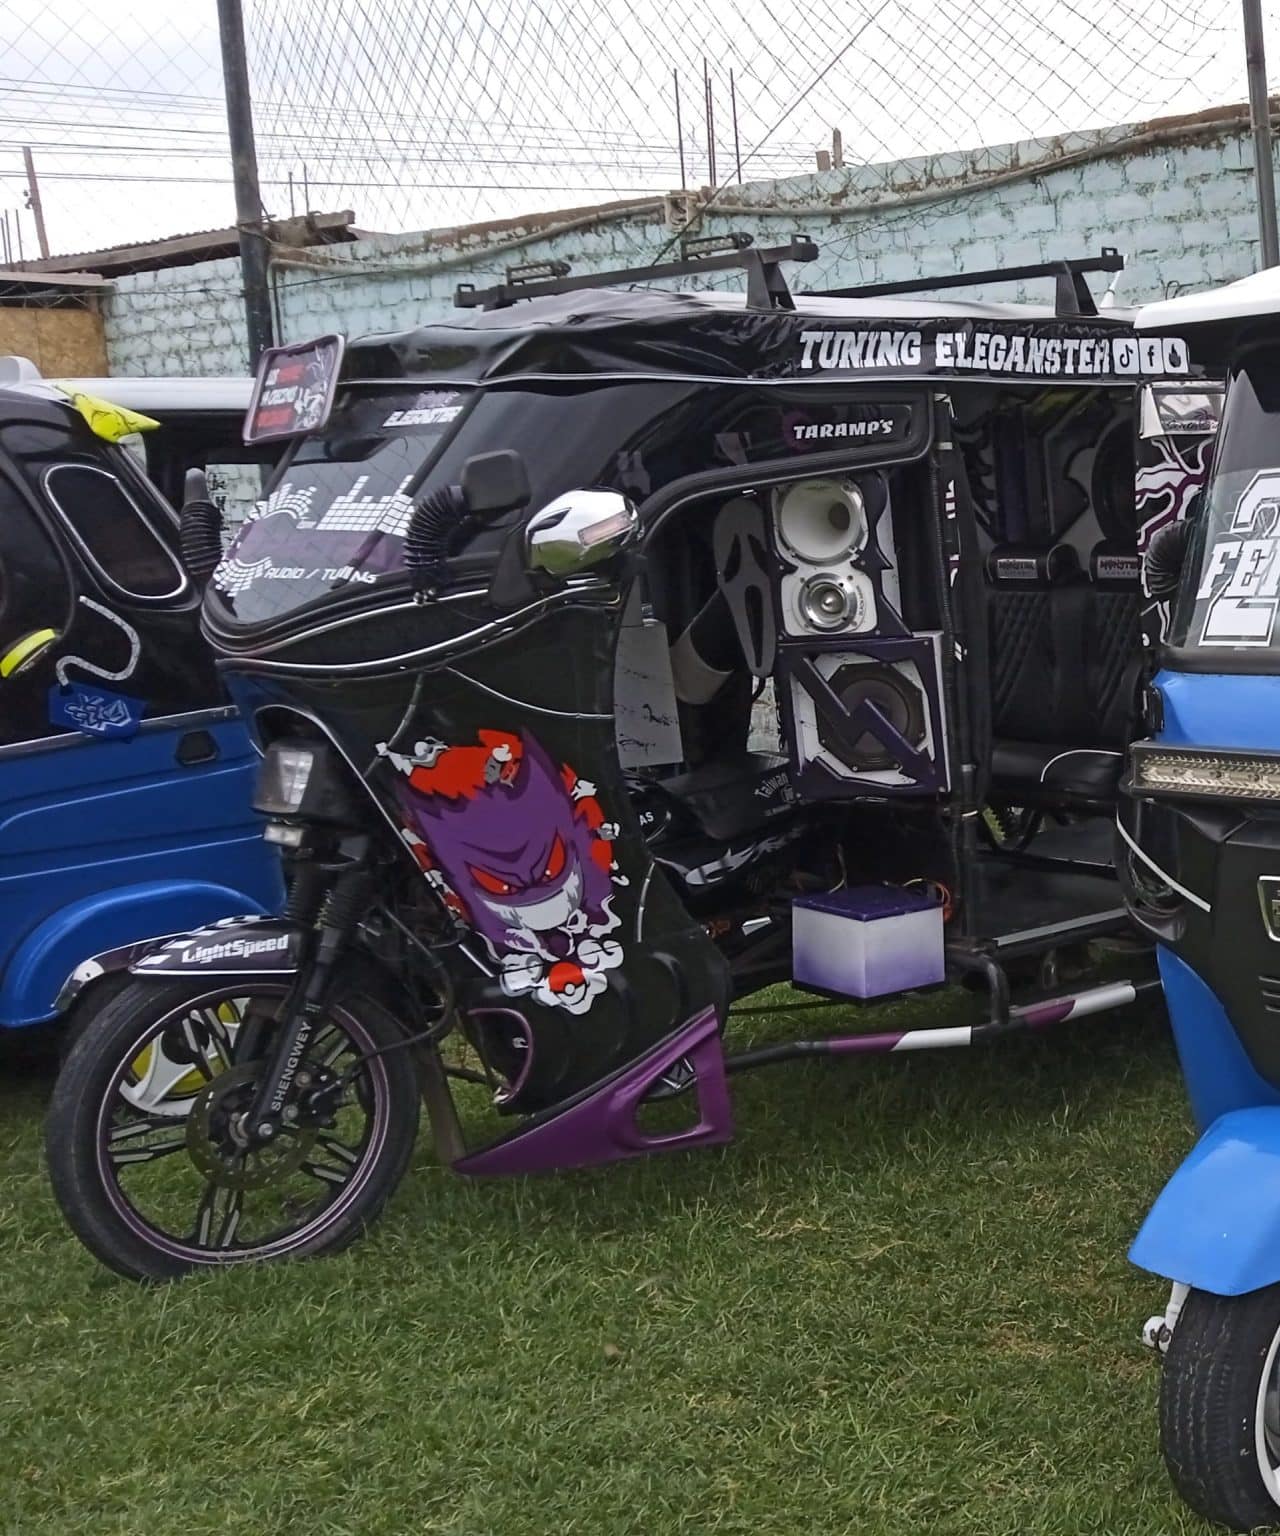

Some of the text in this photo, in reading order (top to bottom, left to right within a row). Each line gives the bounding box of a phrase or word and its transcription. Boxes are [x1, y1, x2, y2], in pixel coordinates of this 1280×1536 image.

[800, 331, 921, 369] TUNING
[935, 332, 1110, 374] ELEGANSTER
[794, 420, 893, 440] TARAMP'S
[181, 934, 289, 964] LightSpeed
[270, 1020, 313, 1112] SHENGWEY
